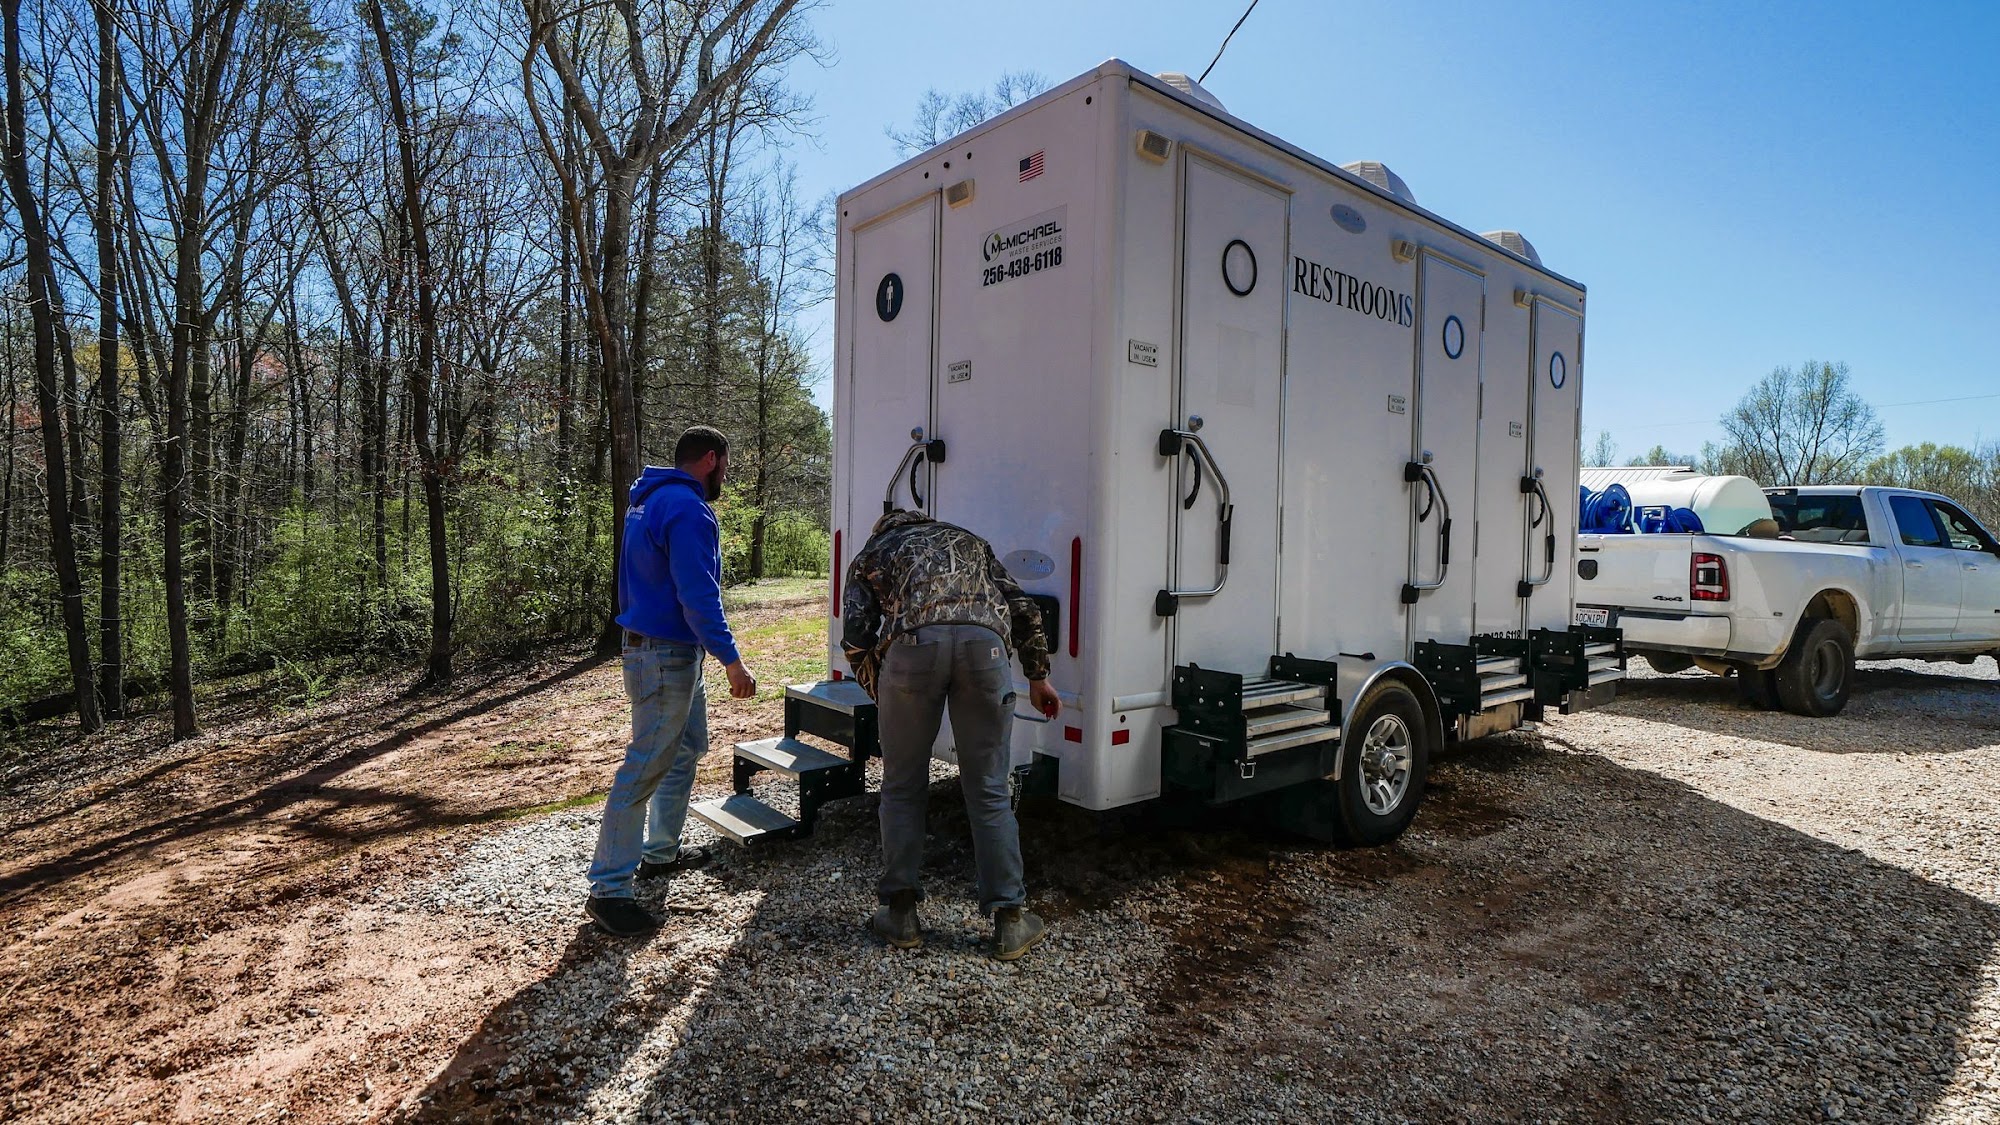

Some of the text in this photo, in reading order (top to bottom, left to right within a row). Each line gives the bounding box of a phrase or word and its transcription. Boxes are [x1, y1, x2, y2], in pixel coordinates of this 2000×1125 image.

[1009, 235, 1062, 258] WASTE SERVICES
[983, 246, 1062, 287] 256-438-6118
[1293, 256, 1413, 328] RESTROOMS
[1134, 343, 1152, 353] VACANT
[1142, 355, 1152, 363] USE
